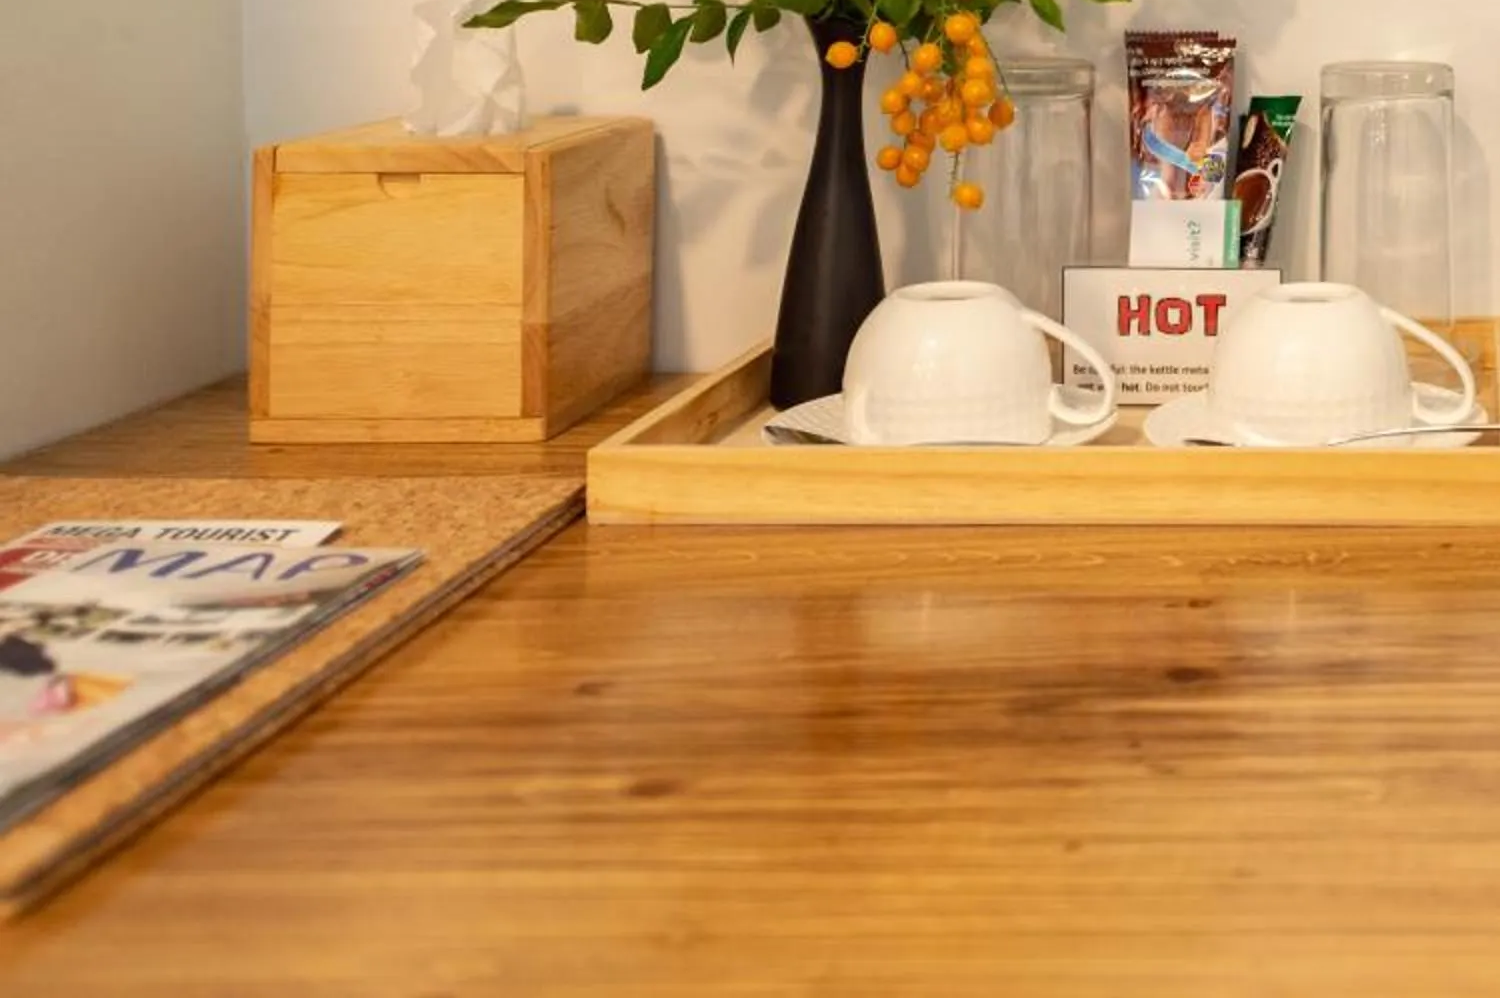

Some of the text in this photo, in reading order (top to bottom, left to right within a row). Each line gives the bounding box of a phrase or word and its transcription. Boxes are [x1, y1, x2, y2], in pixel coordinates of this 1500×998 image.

[1117, 294, 1227, 336] HOT
[1149, 363, 1179, 375] kettle
[1145, 381, 1161, 393] Do
[153, 526, 302, 543] TOURIST
[70, 547, 370, 581] MAP
